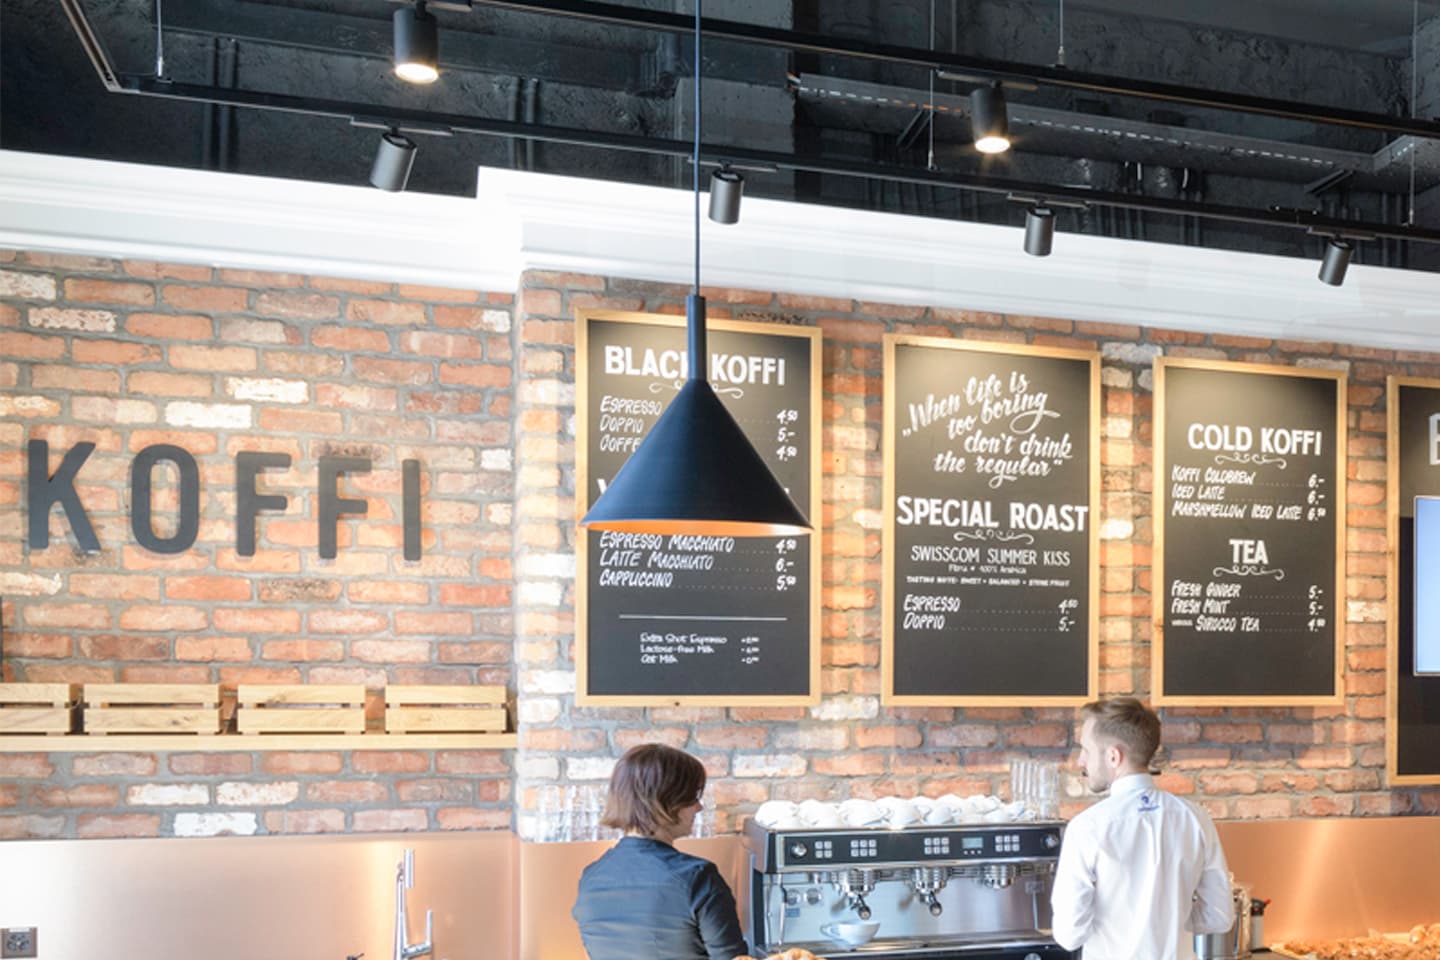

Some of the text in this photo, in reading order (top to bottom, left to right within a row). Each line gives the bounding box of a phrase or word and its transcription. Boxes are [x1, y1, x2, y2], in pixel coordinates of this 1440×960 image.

[711, 353, 785, 385] KOFFI
[964, 373, 1003, 406] life
[1009, 371, 1030, 394] is
[600, 395, 662, 416] ESPRESSO
[947, 392, 1061, 440] too boring
[600, 415, 644, 434] DOPPIO
[1019, 432, 1073, 460] drink
[1187, 422, 1322, 456] COLD KOFFI
[934, 450, 966, 474] the
[1172, 464, 1200, 482] KOFFI
[27, 439, 422, 562] KOFFI
[1172, 483, 1195, 498] ICED
[1198, 485, 1226, 500] LATTE
[896, 495, 1089, 532] SPECIAL ROAST
[1251, 503, 1274, 520] ICED
[1276, 505, 1303, 520] LATTE
[600, 530, 662, 550] ESPRESSO
[668, 535, 735, 552] MACCHIATO
[1229, 538, 1269, 565] TEA
[600, 549, 642, 567] LATTE
[648, 551, 714, 570] MACCHIATO
[911, 545, 1071, 567] SWISSCOM SUMMER KISS
[600, 568, 673, 587] CAPPUCCINO
[1171, 579, 1202, 597] FRESH
[1205, 581, 1242, 598] GINGER
[903, 594, 961, 613] ESPRESSO
[1171, 597, 1201, 614] FRESH
[1203, 598, 1231, 614] MINT
[903, 612, 945, 630] DOPPIO
[1195, 614, 1237, 632] SIROCCO
[1241, 617, 1260, 632] TEA
